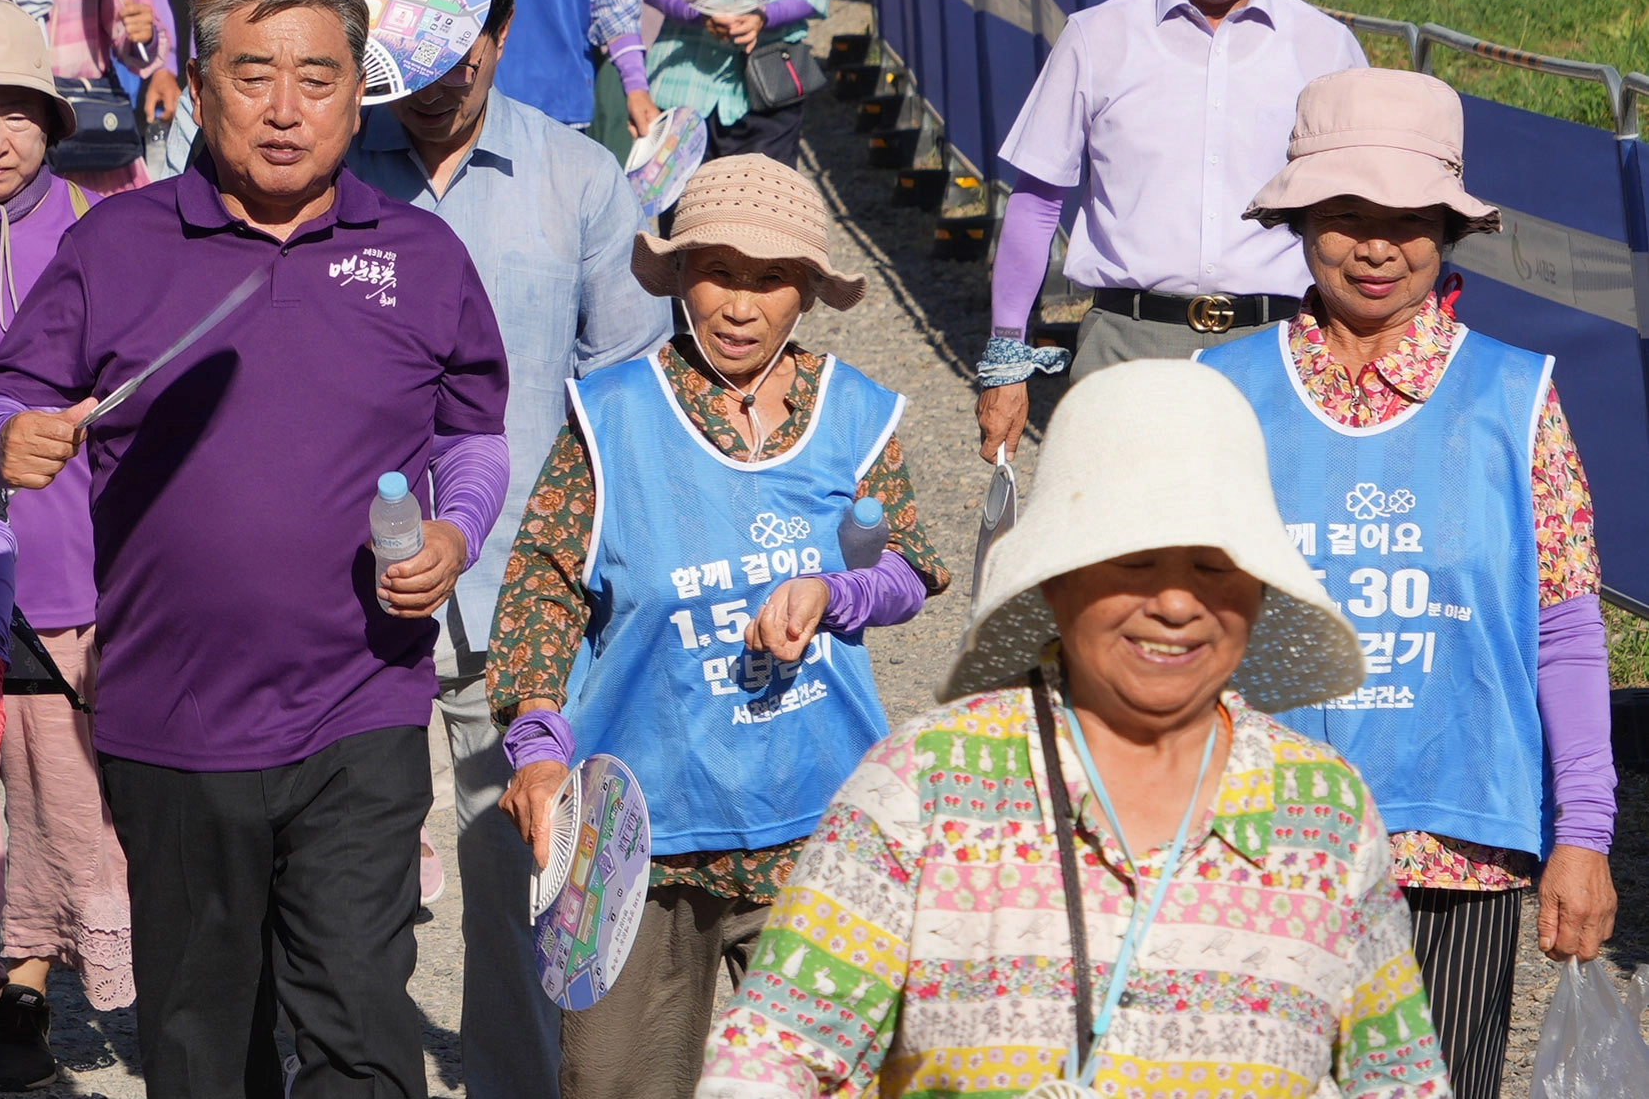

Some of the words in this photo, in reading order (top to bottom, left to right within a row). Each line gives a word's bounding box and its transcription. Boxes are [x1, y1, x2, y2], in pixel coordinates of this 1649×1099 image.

[1327, 522, 1424, 557] 걸어요
[670, 557, 733, 600] 함께
[740, 547, 823, 585] 걸어요
[1444, 604, 1472, 622] 이상
[702, 630, 833, 697] 만보기
[1305, 685, 1415, 711] 군보건소
